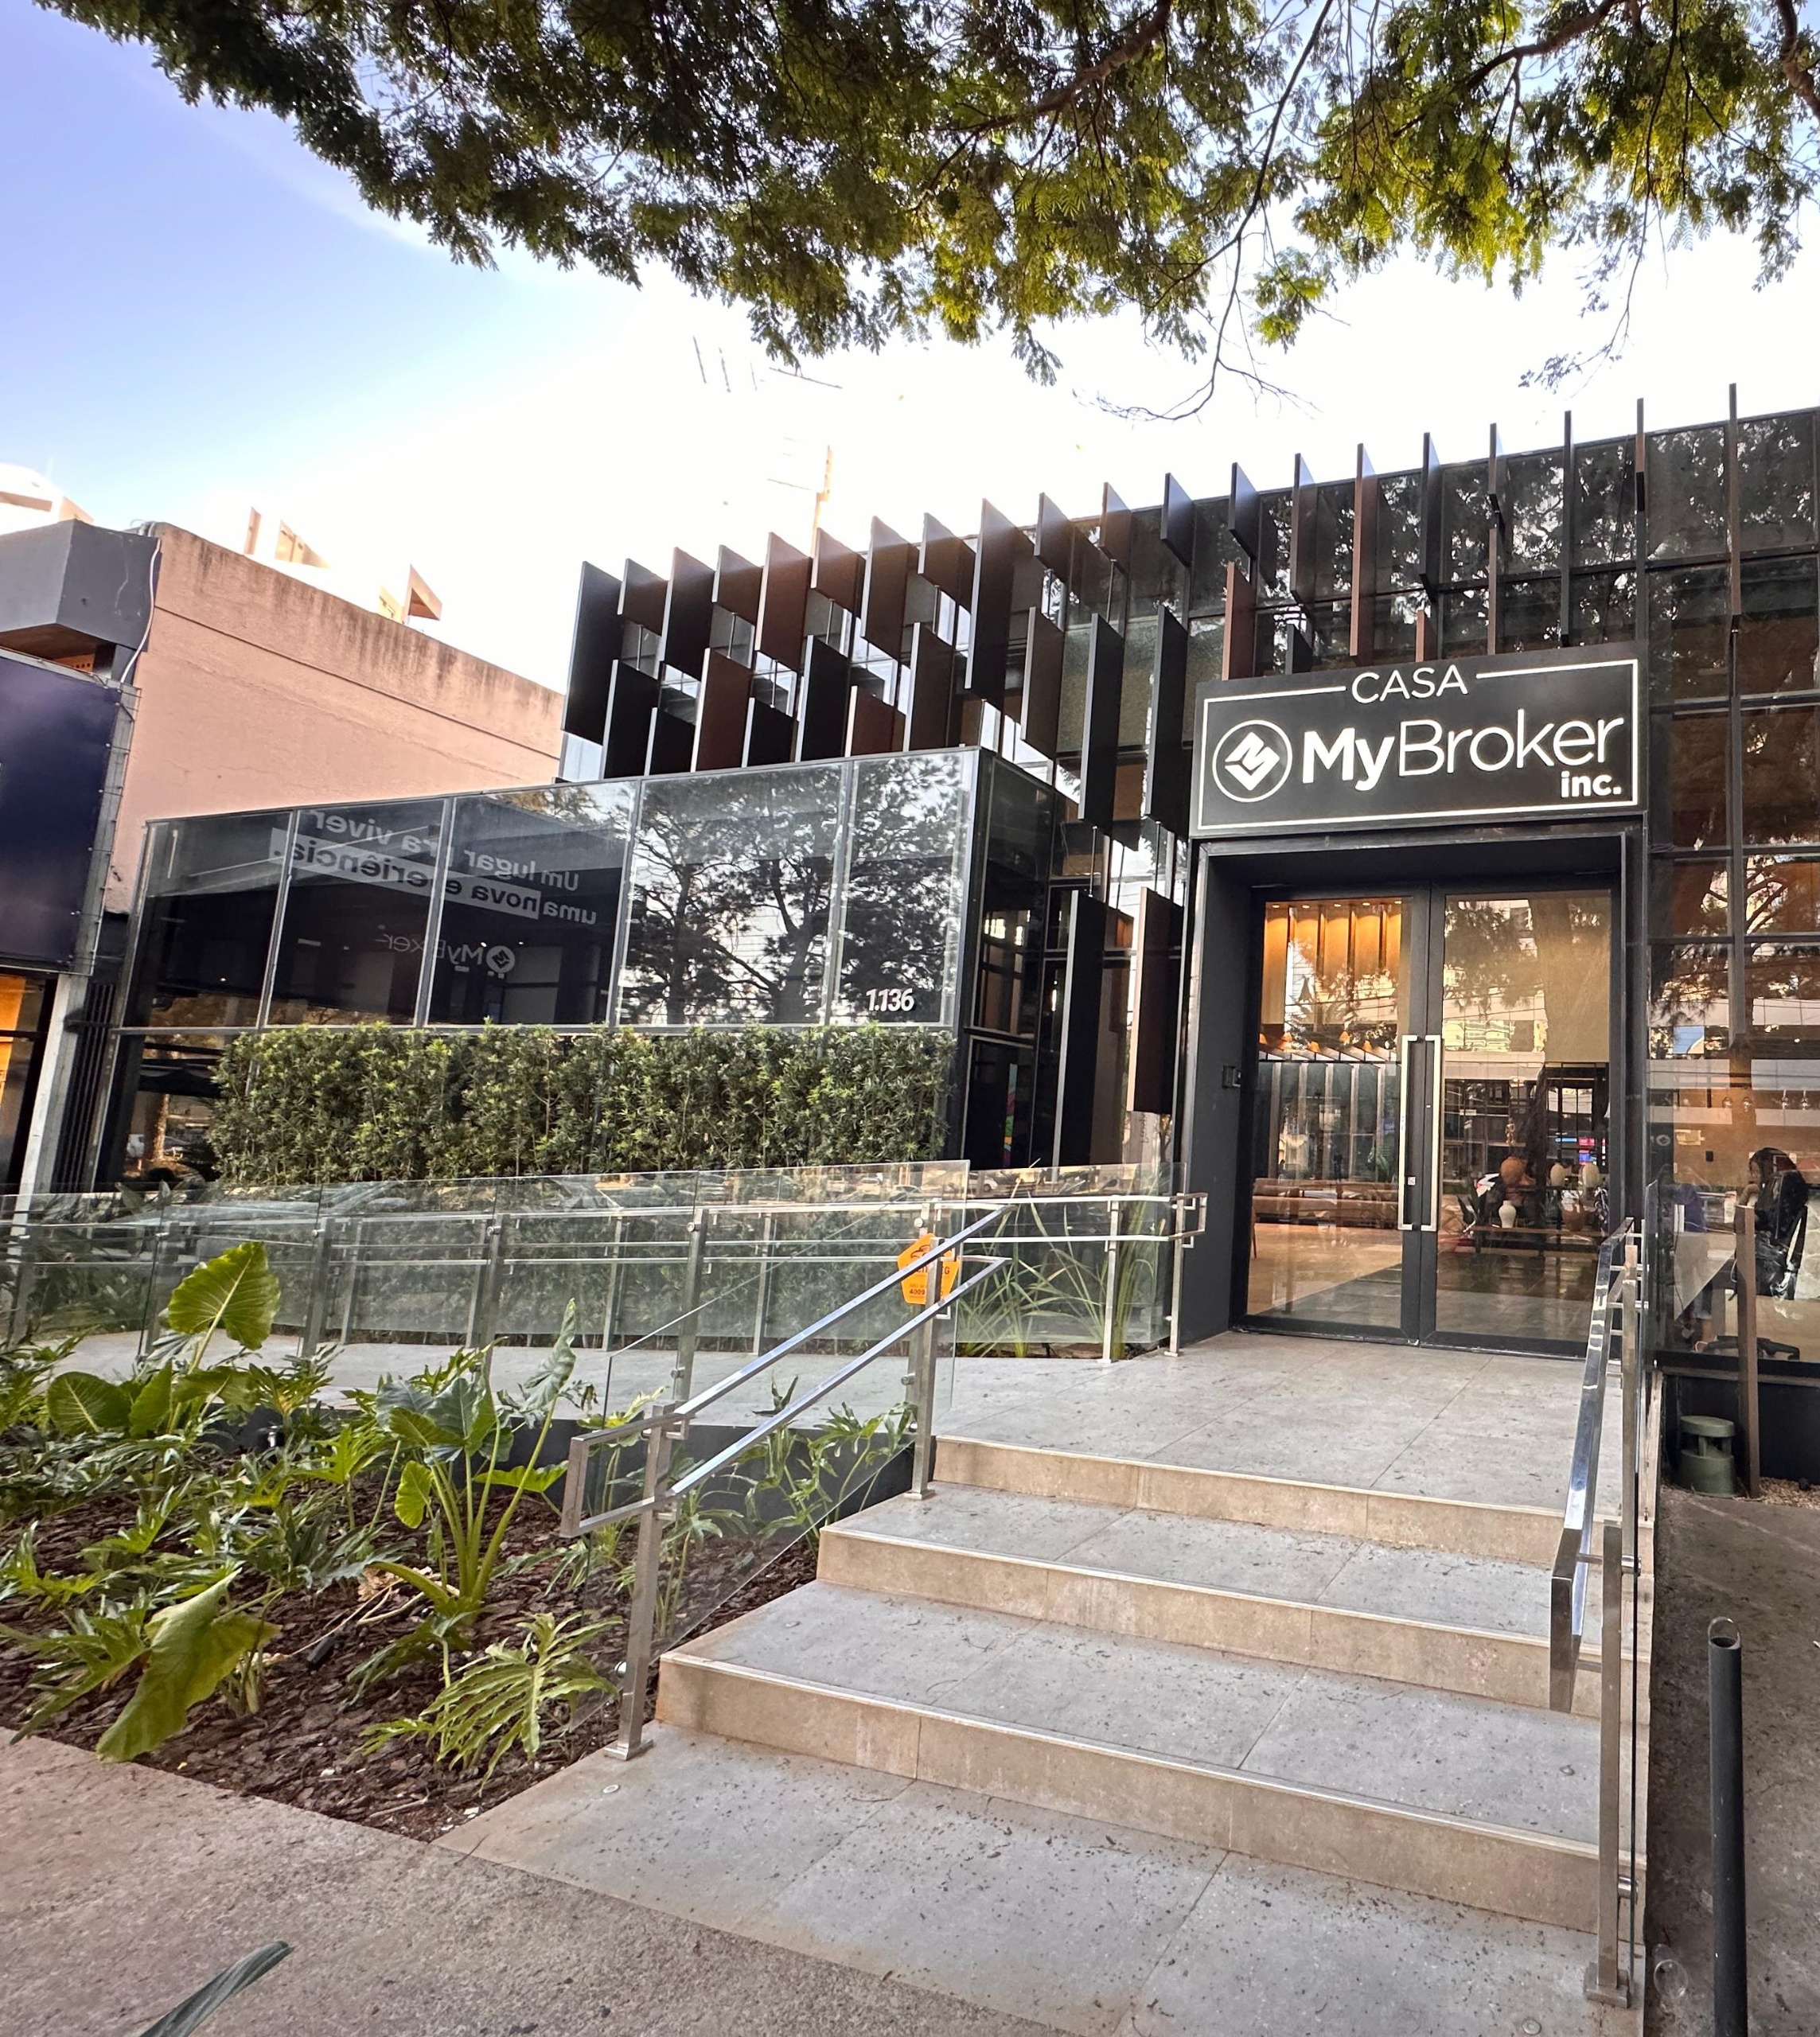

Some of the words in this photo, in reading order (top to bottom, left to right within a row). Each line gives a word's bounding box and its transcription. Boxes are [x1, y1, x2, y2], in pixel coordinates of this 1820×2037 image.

[1351, 664, 1468, 703] CASA
[1301, 708, 1624, 791] MyBroker
[1560, 770, 1623, 799] inc.
[865, 987, 915, 1012] 1.136
